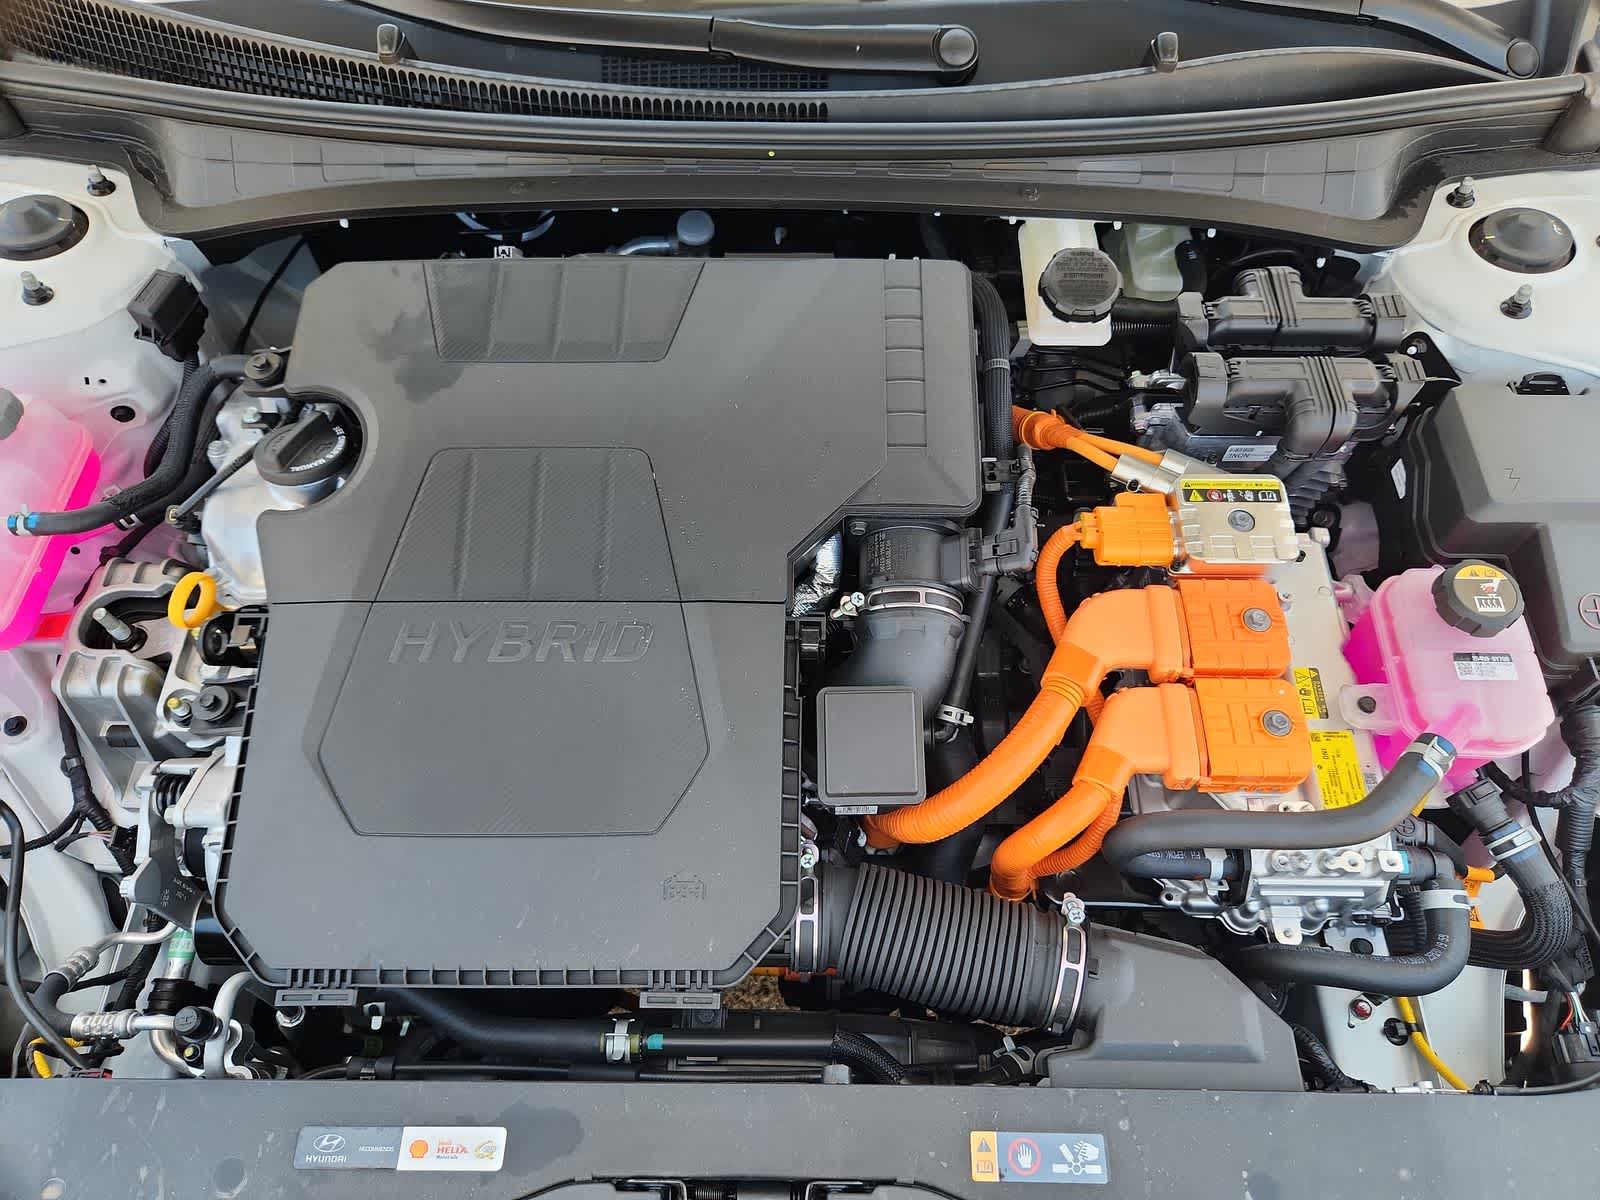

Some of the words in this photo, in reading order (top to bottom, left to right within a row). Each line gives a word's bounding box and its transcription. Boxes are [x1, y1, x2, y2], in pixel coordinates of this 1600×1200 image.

[387, 619, 654, 665] HYBRID
[437, 1145, 469, 1154] HELIX
[305, 1155, 347, 1163] HYUNDAI
